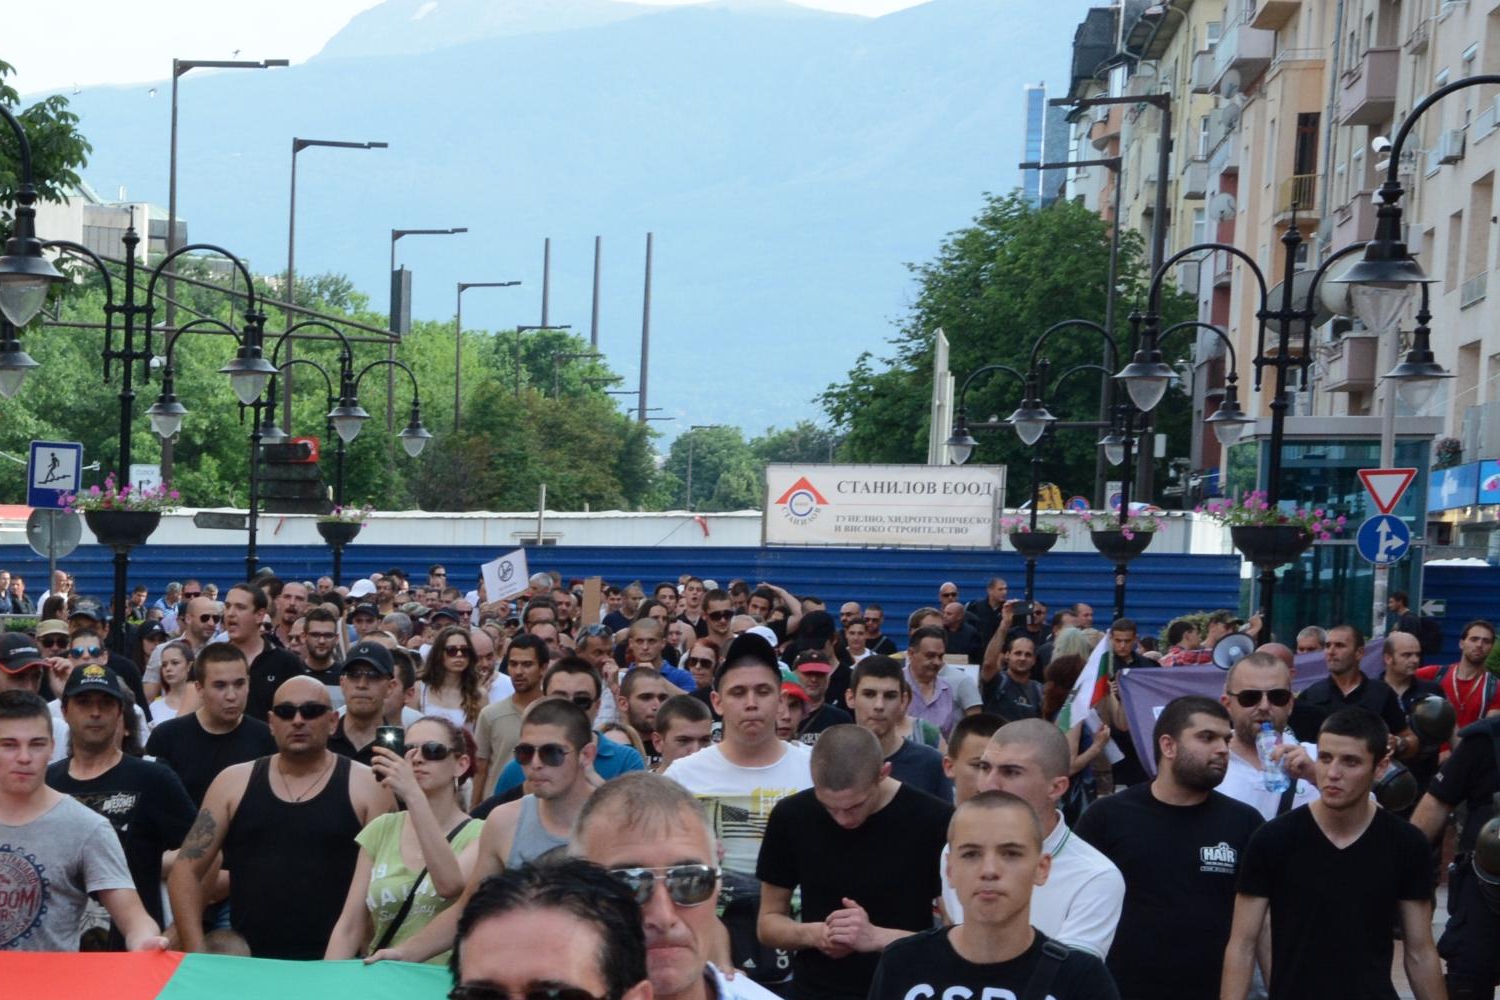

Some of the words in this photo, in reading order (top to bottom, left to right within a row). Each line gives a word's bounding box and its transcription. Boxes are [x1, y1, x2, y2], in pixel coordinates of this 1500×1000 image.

[836, 480, 937, 495] СТАНИЛОВ
[942, 481, 993, 497] ЕООД
[844, 526, 885, 534] ВИСОКО
